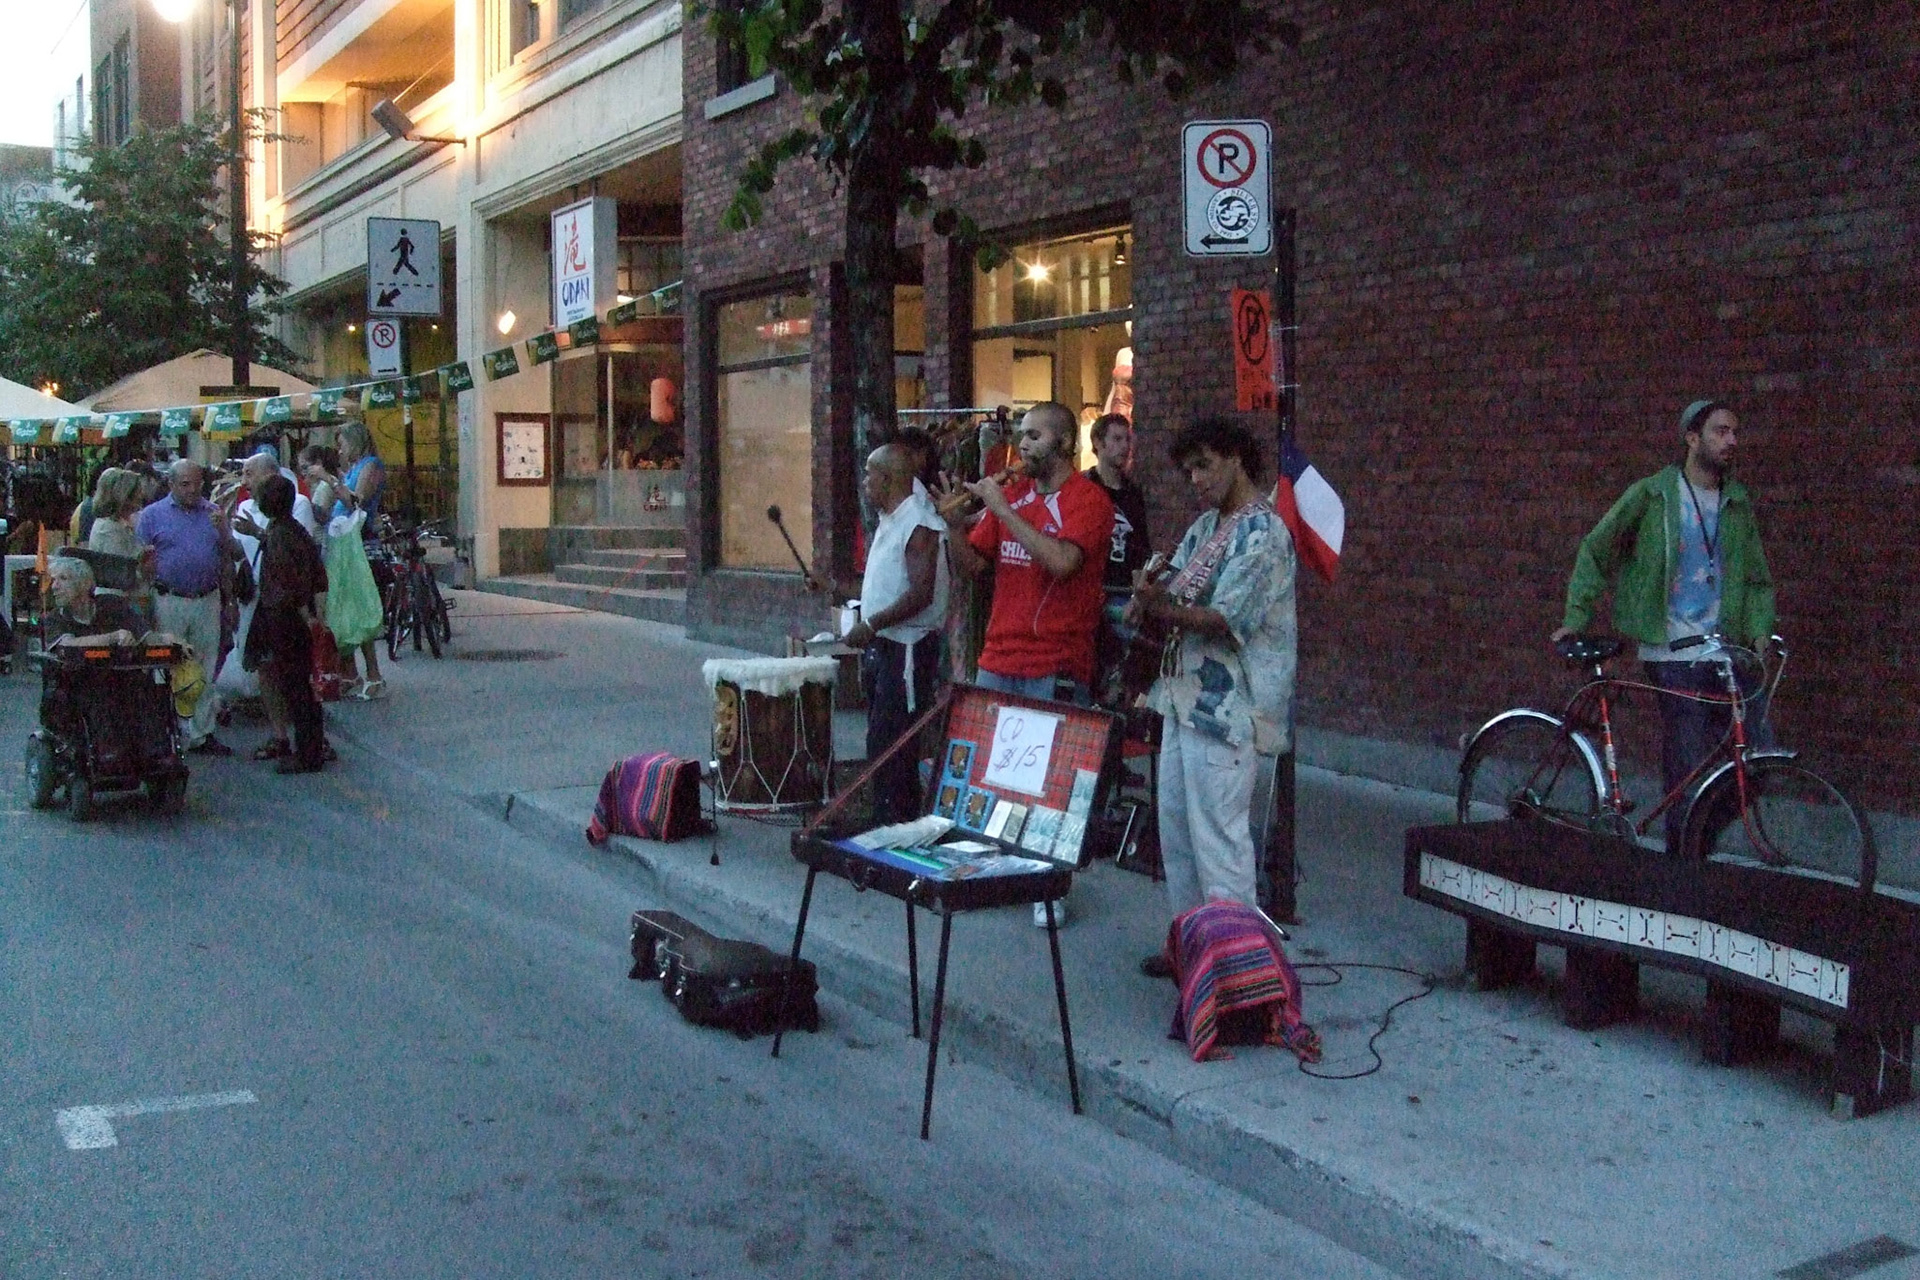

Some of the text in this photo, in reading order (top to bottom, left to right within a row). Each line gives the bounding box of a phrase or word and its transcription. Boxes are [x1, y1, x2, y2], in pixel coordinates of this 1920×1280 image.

[1218, 142, 1240, 174] P
[562, 276, 590, 307] ODAN
[1001, 540, 1032, 561] CHIL
[1000, 715, 1025, 743] CD
[993, 744, 1046, 773] $15
